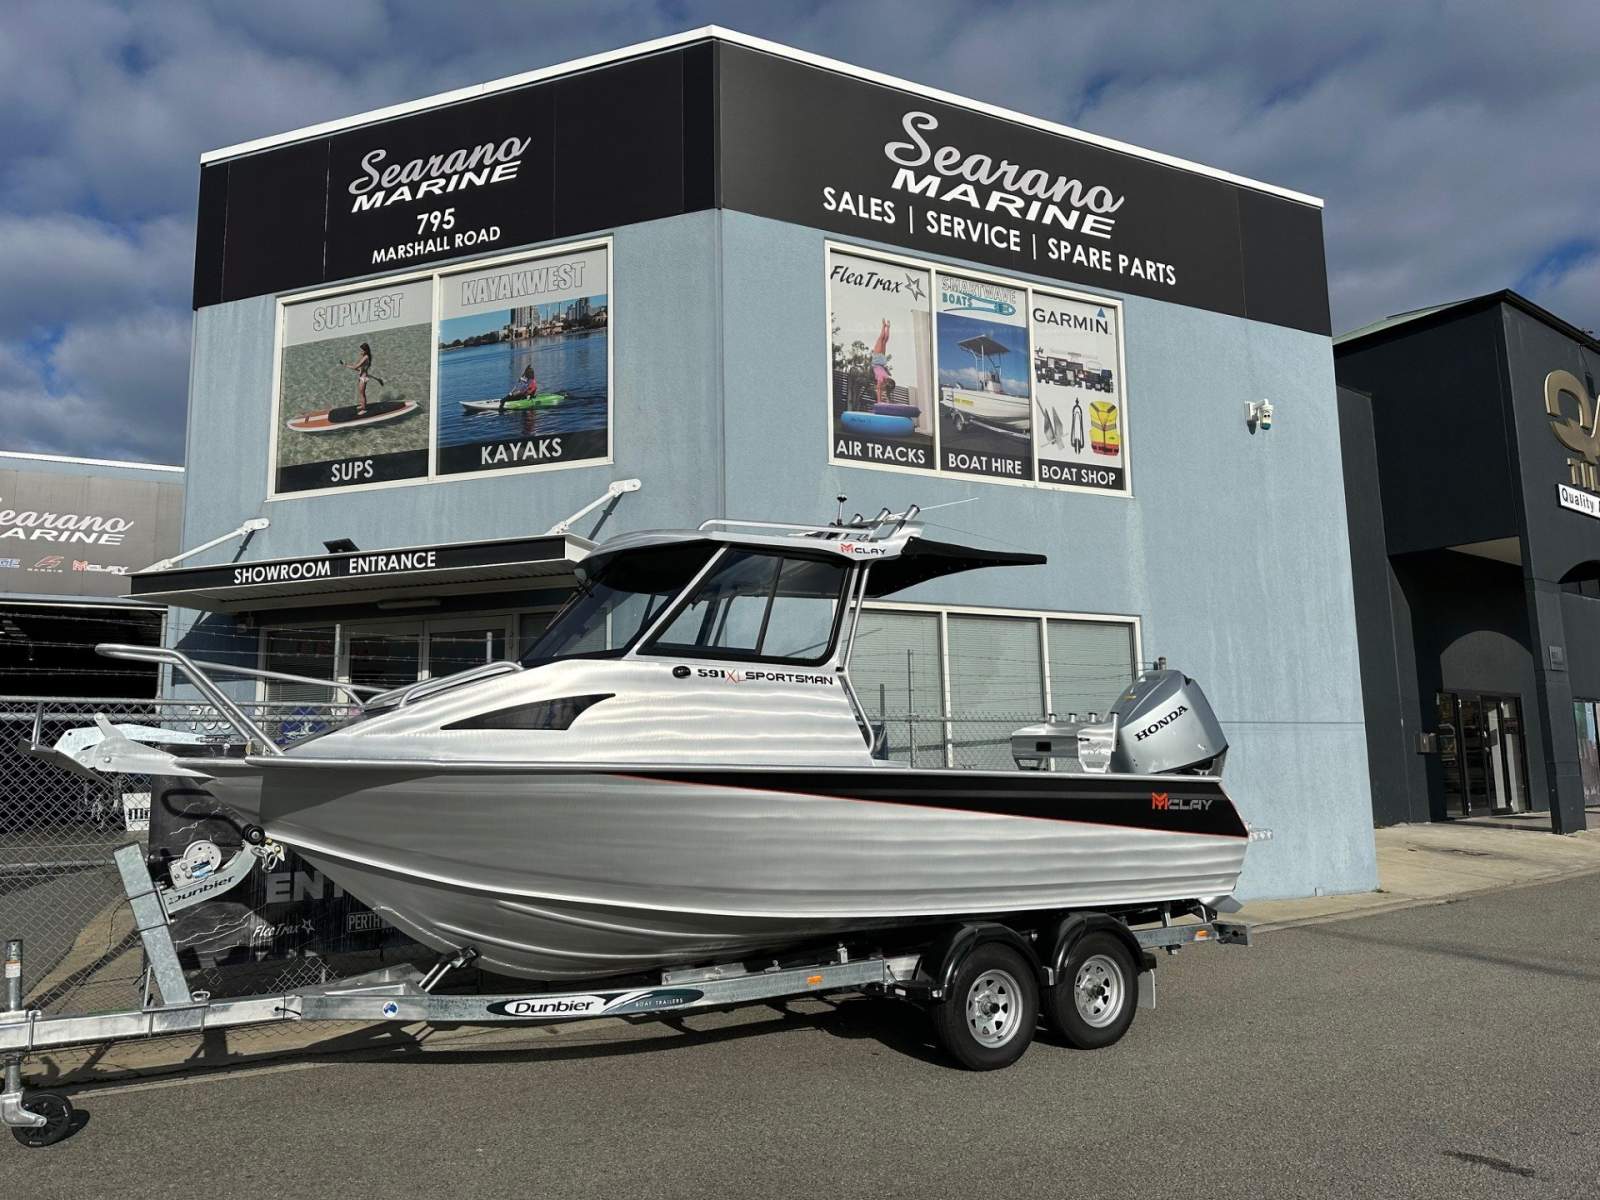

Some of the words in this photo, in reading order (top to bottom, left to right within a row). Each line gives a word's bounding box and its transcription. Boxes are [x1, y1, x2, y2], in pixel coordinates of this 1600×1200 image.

[348, 136, 532, 196] Searano
[885, 112, 1124, 213] Searano
[351, 160, 522, 214] MARINE
[891, 168, 1116, 240] MARINE
[416, 207, 456, 236] 795
[372, 240, 450, 264] MARSHALL
[455, 225, 501, 249] ROAD
[822, 186, 897, 224] SALES
[925, 210, 1021, 252] SERVICE
[1047, 238, 1113, 272] SPARE
[1118, 257, 1176, 285] PARTS
[461, 262, 586, 306] KAYAKWEST
[830, 264, 903, 294] FleaTrax
[942, 276, 1016, 305] SMARTWAVE
[313, 293, 404, 333] SUPWEST
[942, 292, 972, 309] BOATS
[1032, 308, 1108, 335] GARMIN
[480, 438, 562, 465] KAYAKS
[836, 439, 862, 457] AIR
[866, 442, 926, 464] TRACKS
[948, 453, 986, 472] BOAT
[991, 460, 1022, 475] HIRE
[330, 460, 374, 483] SUPS
[1041, 464, 1077, 482] BOAT
[1080, 468, 1117, 486] SHOP
[1561, 487, 1594, 514] Quality
[0, 509, 134, 532] earano
[0, 527, 125, 545] ARINE
[233, 560, 331, 584] SHOWROOM
[349, 551, 436, 574] ENTRANCE
[745, 671, 833, 685] SPORTSMAN
[1134, 704, 1188, 742] HONDA
[347, 911, 381, 933] PERTH
[514, 1000, 594, 1015] Dunbier
[655, 997, 684, 1007] TRAILERS
